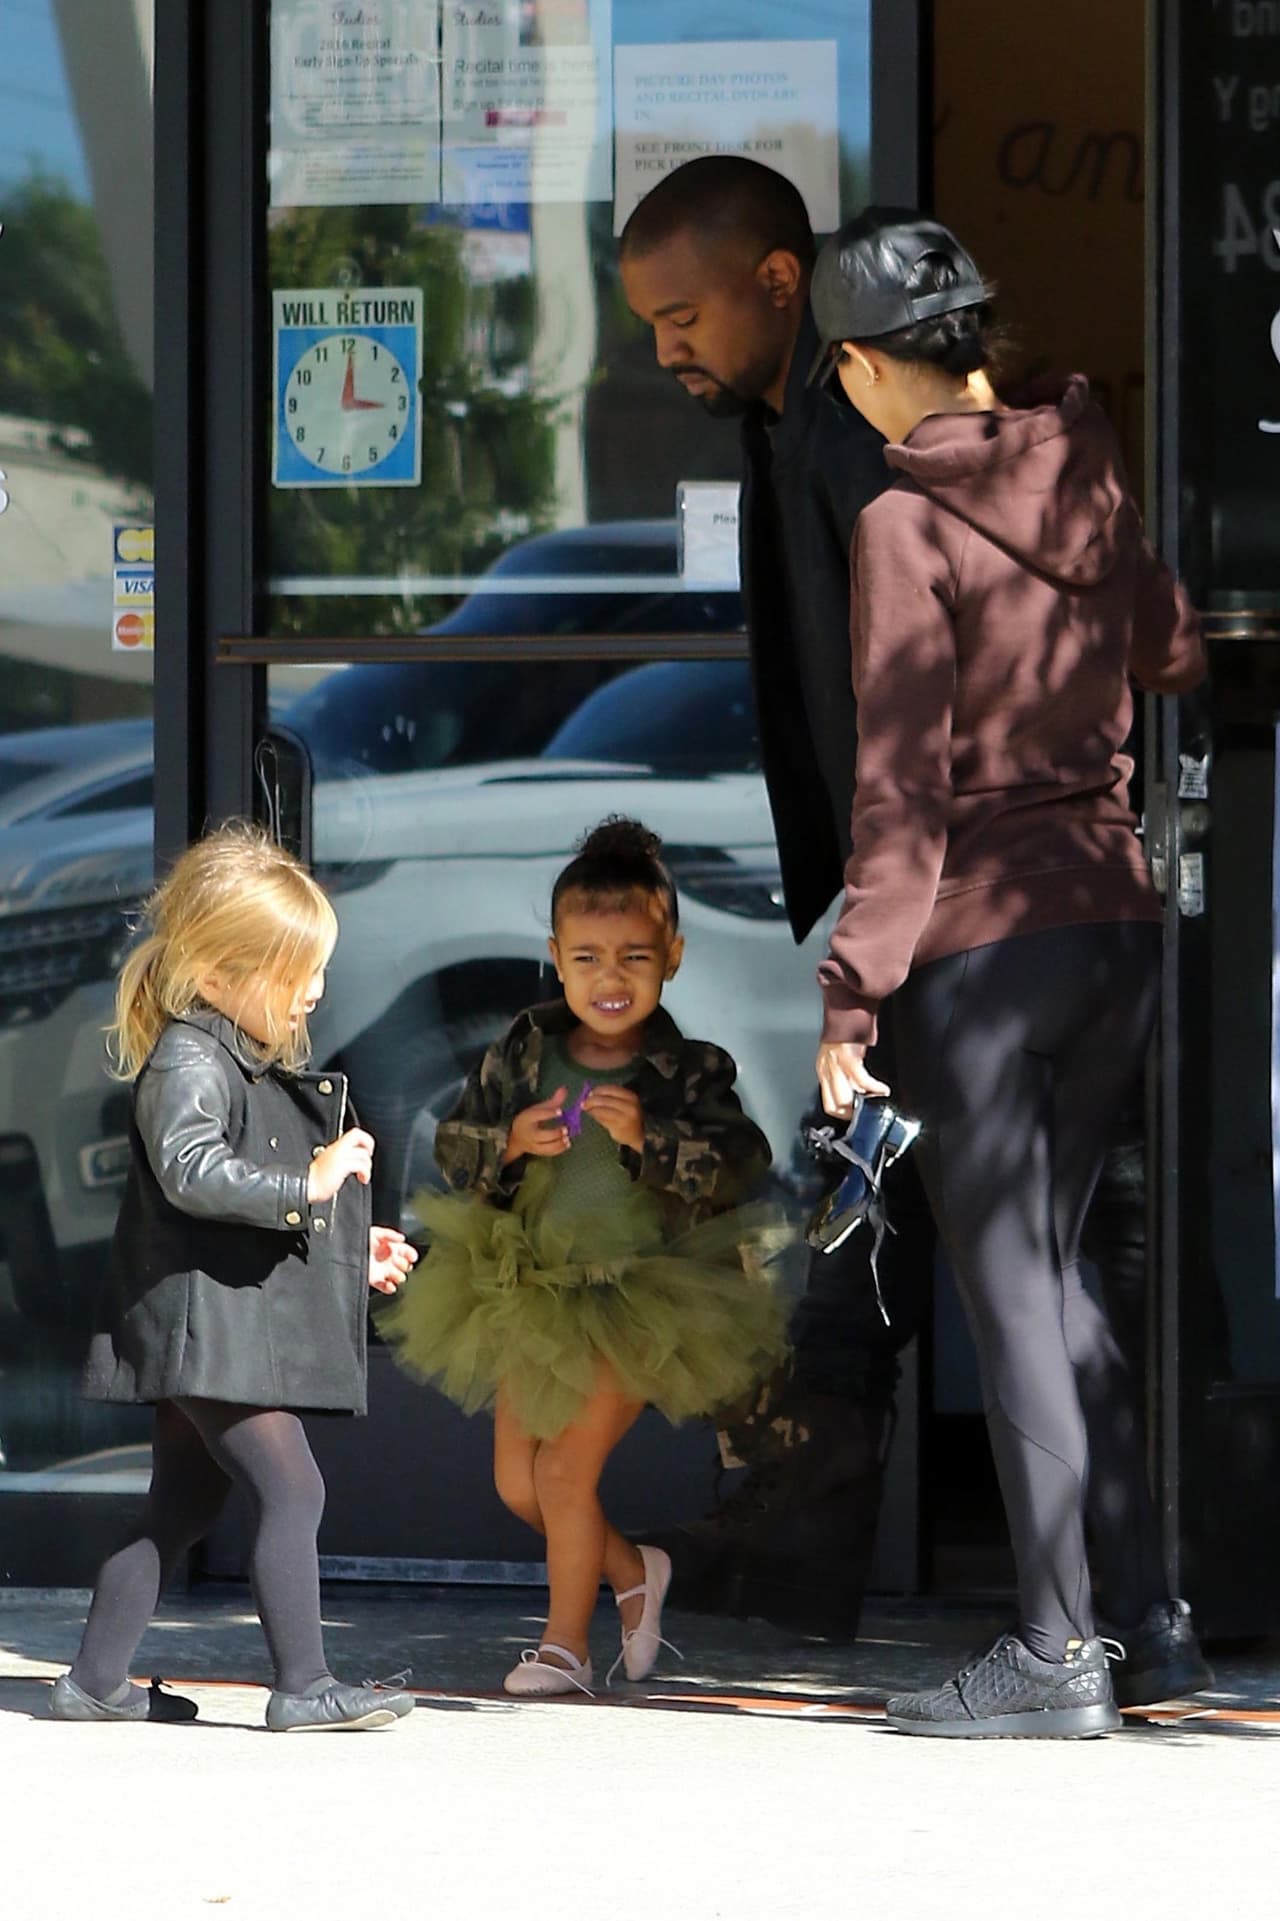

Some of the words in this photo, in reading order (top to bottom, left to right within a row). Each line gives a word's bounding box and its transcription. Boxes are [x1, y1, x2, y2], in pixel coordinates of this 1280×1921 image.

[294, 55, 323, 68] Early
[454, 59, 504, 74] Recital
[507, 58, 541, 74] time
[635, 75, 691, 88] PICTURE
[700, 74, 726, 86] DAY
[731, 72, 788, 85] PHOTOS
[636, 93, 665, 105] AND
[669, 91, 728, 104] RECITAL
[634, 141, 661, 155] SEE
[664, 140, 712, 154] FRONT
[716, 139, 753, 153] DESK
[756, 138, 784, 151] FOR
[634, 158, 666, 172] PICK
[282, 302, 328, 325] WILL
[337, 300, 415, 325] RETURN
[341, 338, 356, 354] 12
[372, 345, 378, 361] 1
[315, 347, 328, 363] 11
[297, 369, 312, 386] 10
[391, 367, 400, 383] 2
[288, 397, 298, 414] 9
[397, 395, 407, 411] 3
[296, 426, 305, 443] 8
[388, 424, 398, 441] 4
[316, 447, 325, 463] 7
[368, 446, 378, 463] 5
[342, 455, 351, 471] 6
